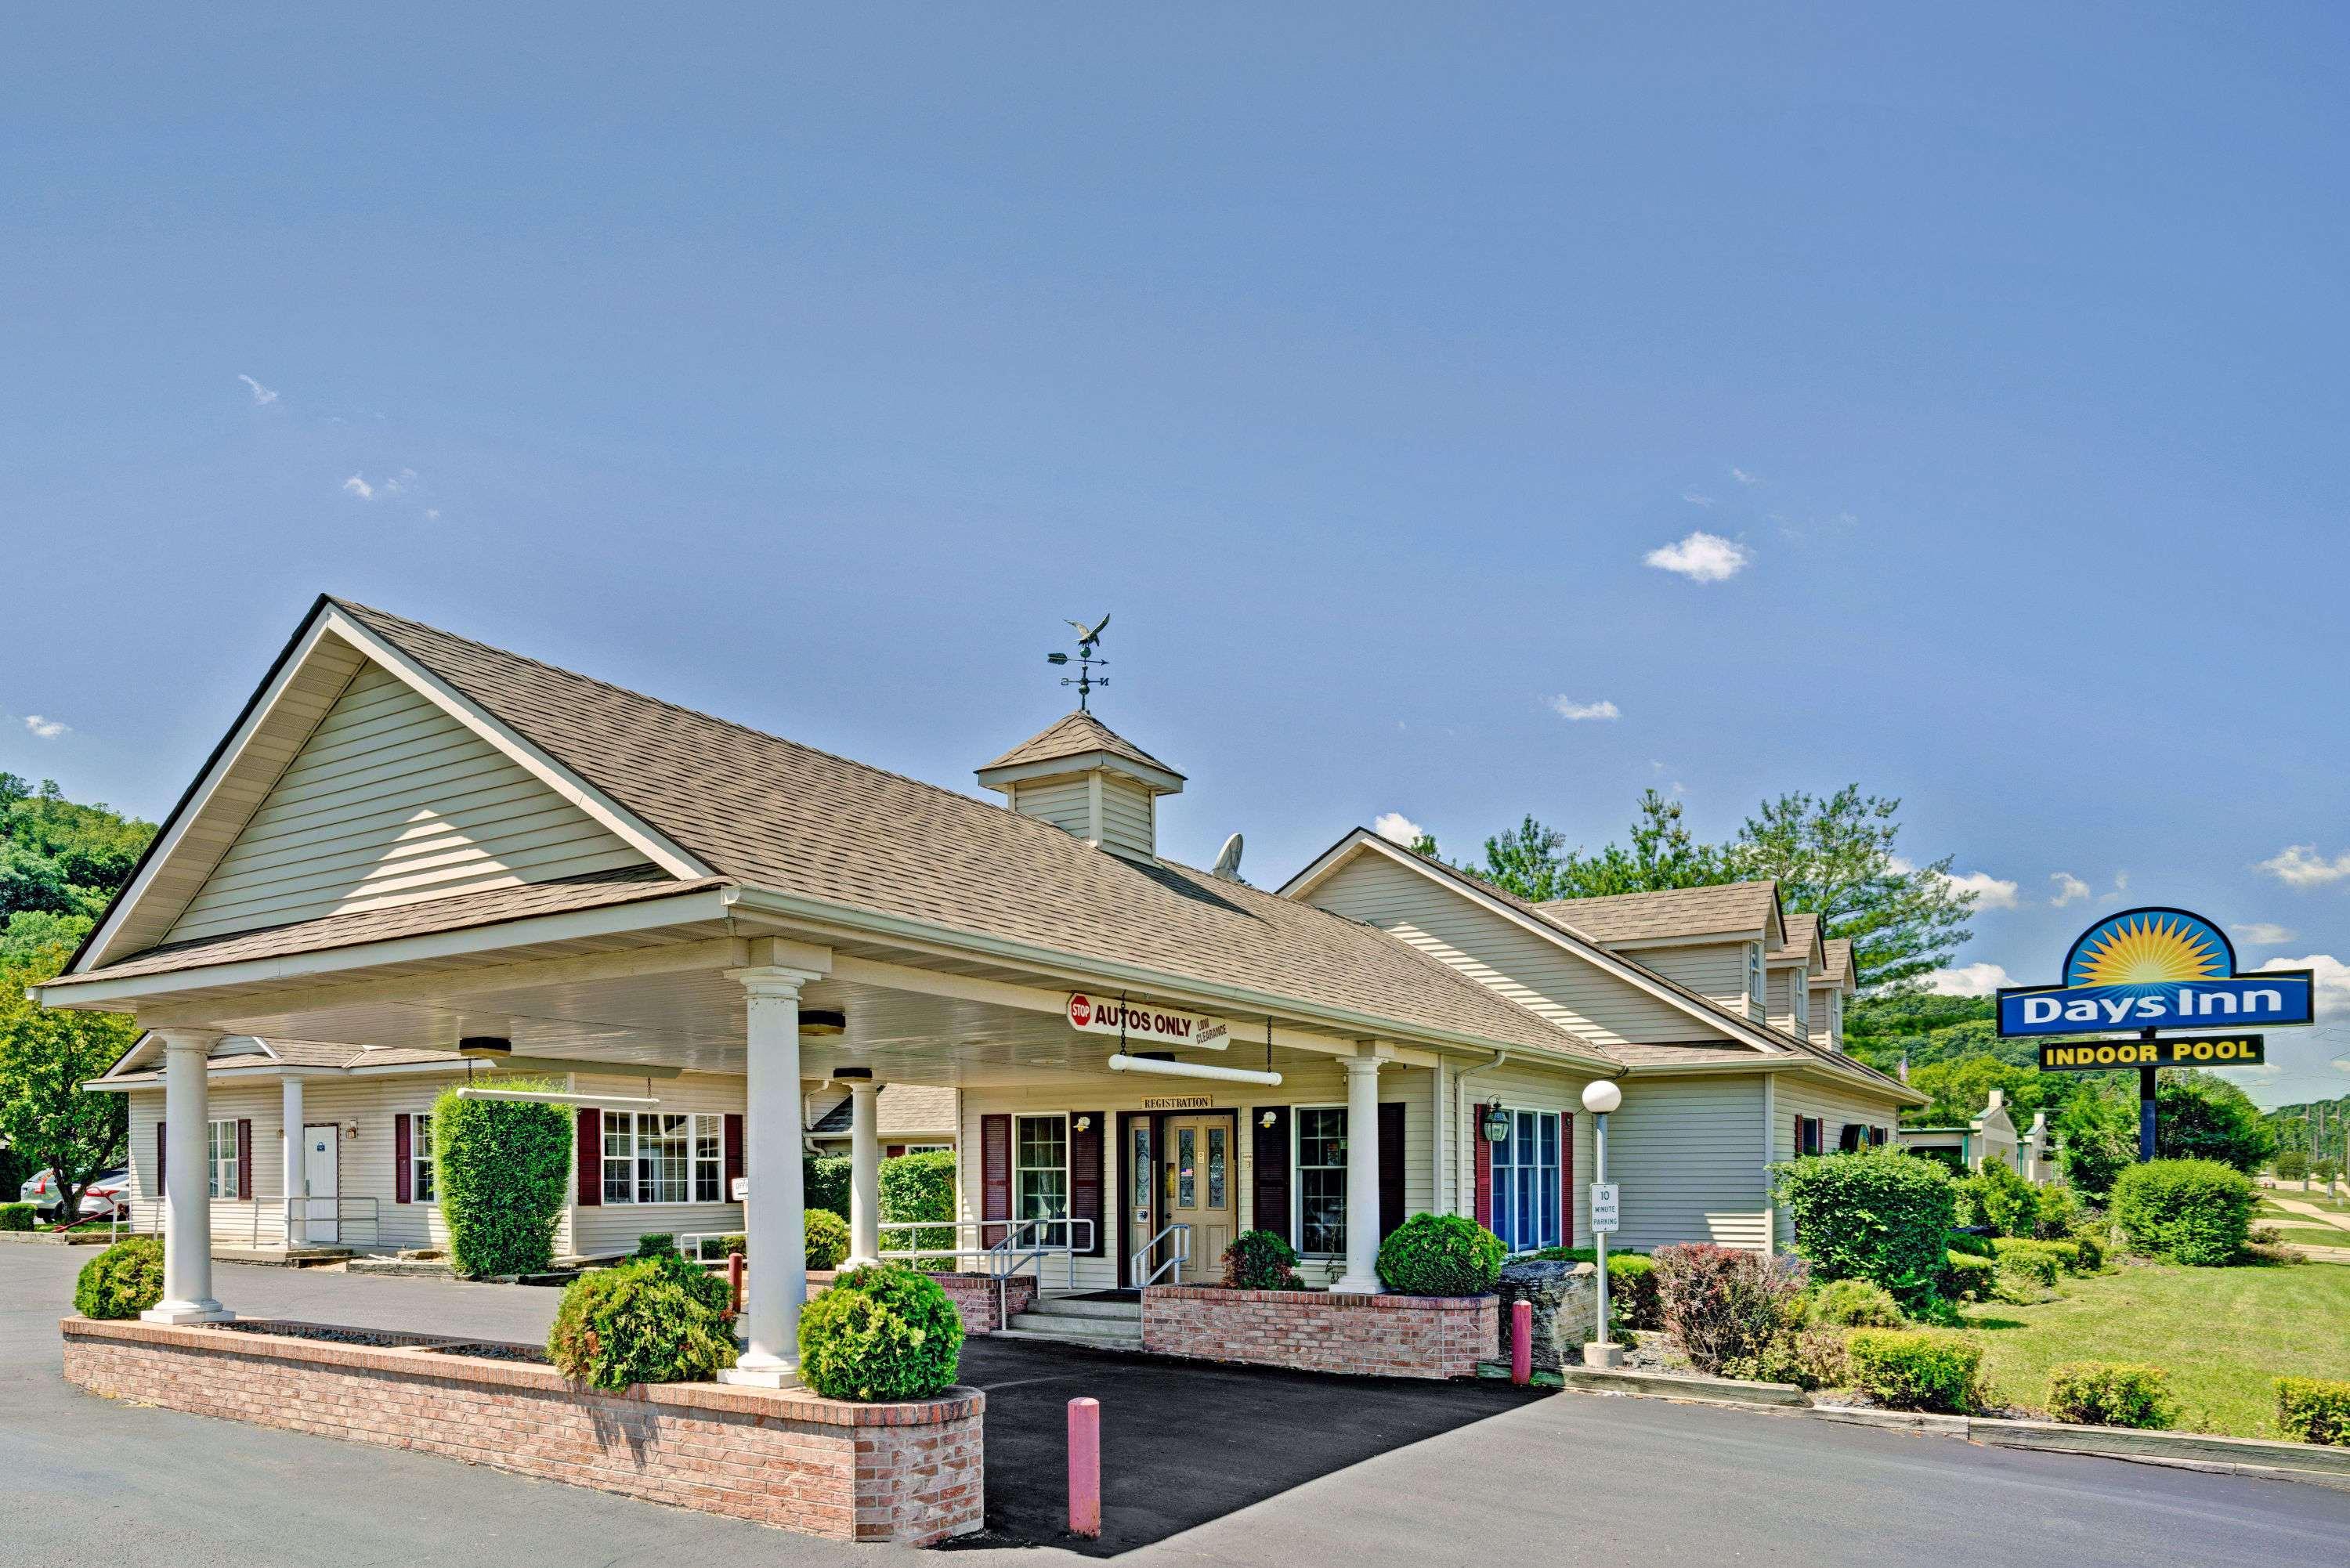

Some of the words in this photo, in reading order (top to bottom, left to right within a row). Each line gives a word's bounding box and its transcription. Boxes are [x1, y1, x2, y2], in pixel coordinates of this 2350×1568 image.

[1072, 1003, 1090, 1017] STOP
[2024, 995, 2167, 1024] Days
[2179, 988, 2282, 1016] Inn
[1094, 1005, 1152, 1031] AUTOS
[1155, 1013, 1191, 1037] ONLY
[1197, 1017, 1209, 1031] LOW
[1196, 1024, 1227, 1045] CLEARANCE
[2046, 1045, 2159, 1065] INDOOR
[2173, 1040, 2256, 1060] POOL
[1144, 1097, 1208, 1108] REGISTRATION
[1600, 1190, 1610, 1201] 10
